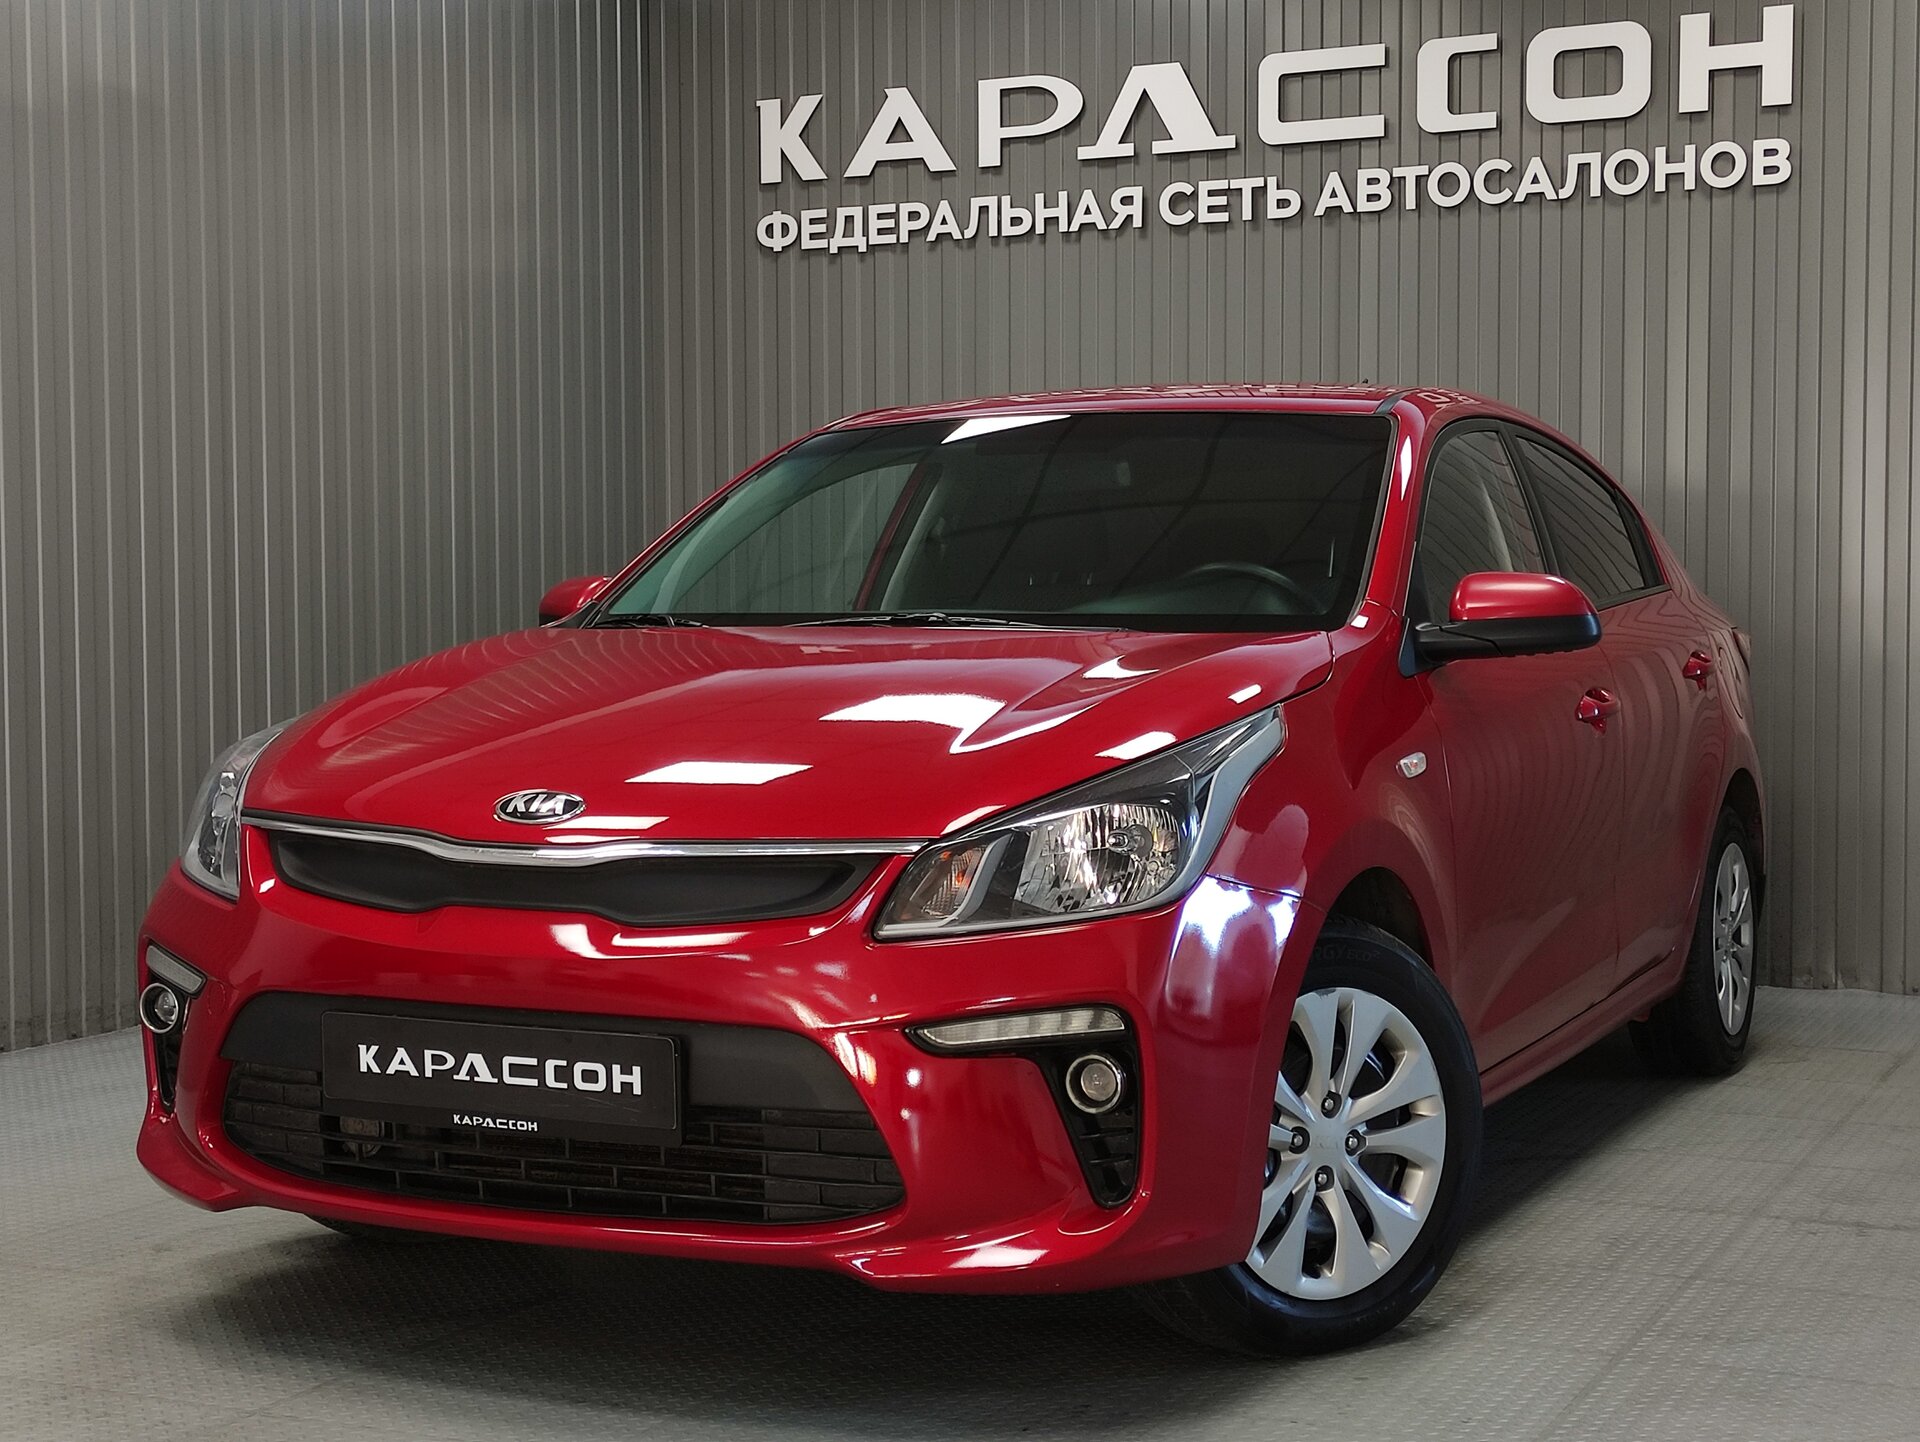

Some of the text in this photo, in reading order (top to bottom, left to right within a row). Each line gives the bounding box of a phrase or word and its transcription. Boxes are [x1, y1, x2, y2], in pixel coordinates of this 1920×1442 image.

[756, 137, 1793, 254] ФЕДЕРАЛЬНАЯ СЕТЬ АВТОСАЛОНОВ
[505, 793, 579, 815] KIA
